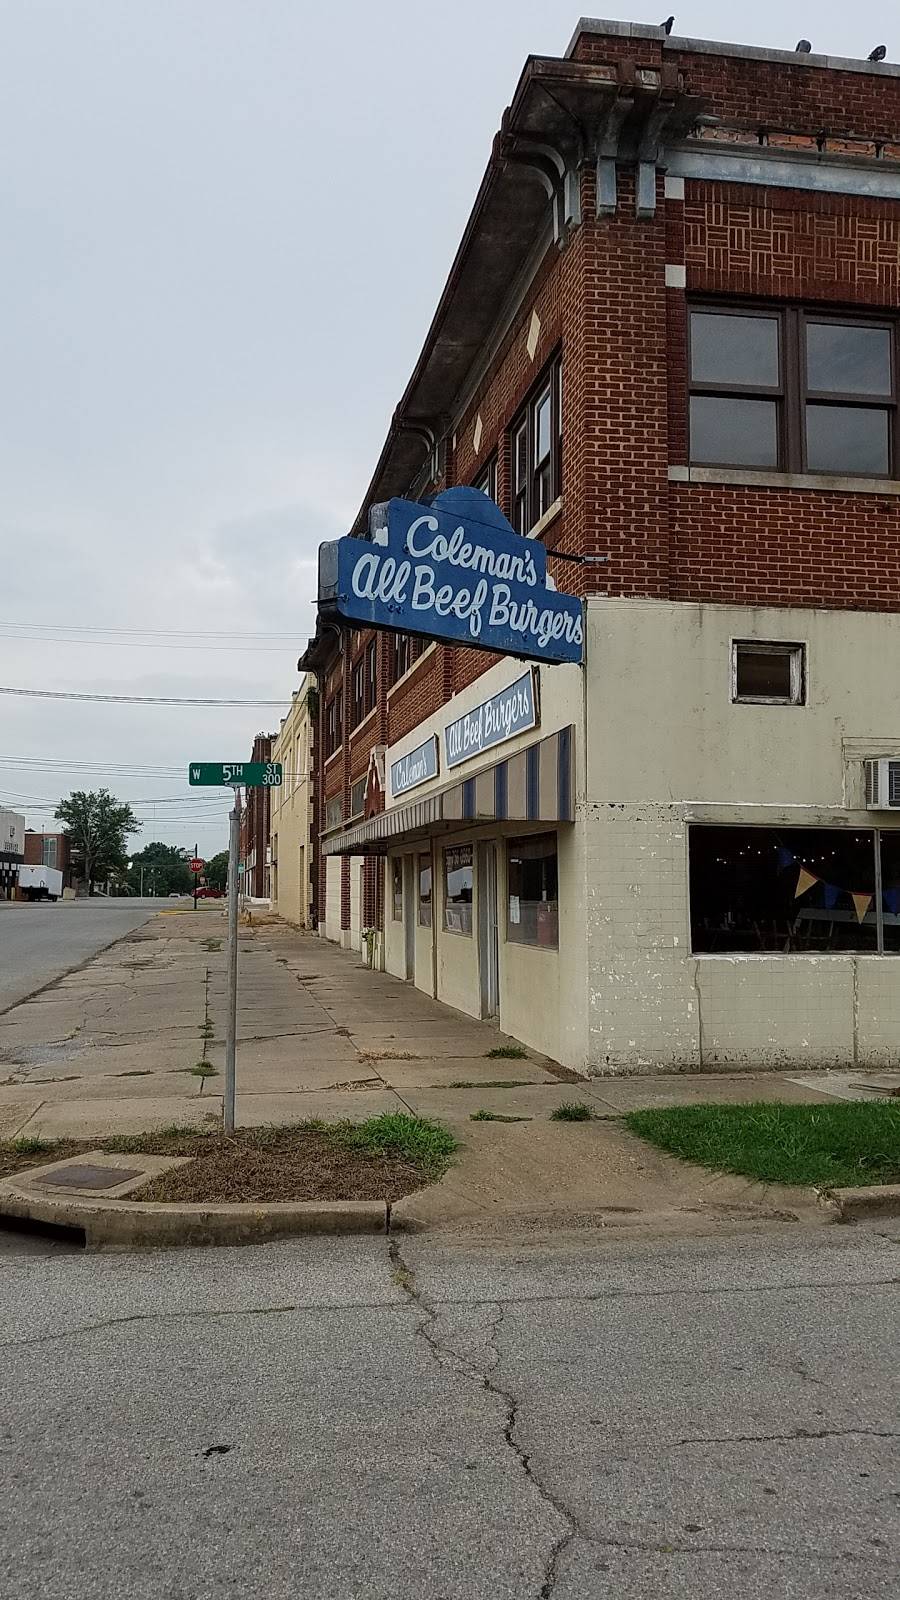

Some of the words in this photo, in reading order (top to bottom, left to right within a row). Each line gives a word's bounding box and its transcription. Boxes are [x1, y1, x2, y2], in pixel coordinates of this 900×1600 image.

[407, 515, 537, 586] Coleman's
[411, 565, 487, 637] Beef
[488, 584, 583, 648] Burgers
[464, 706, 484, 750] Beef
[484, 687, 529, 735] Burgers
[192, 768, 201, 780] W
[222, 764, 243, 781] 5TH
[265, 763, 278, 775] ST
[262, 774, 281, 785] 300
